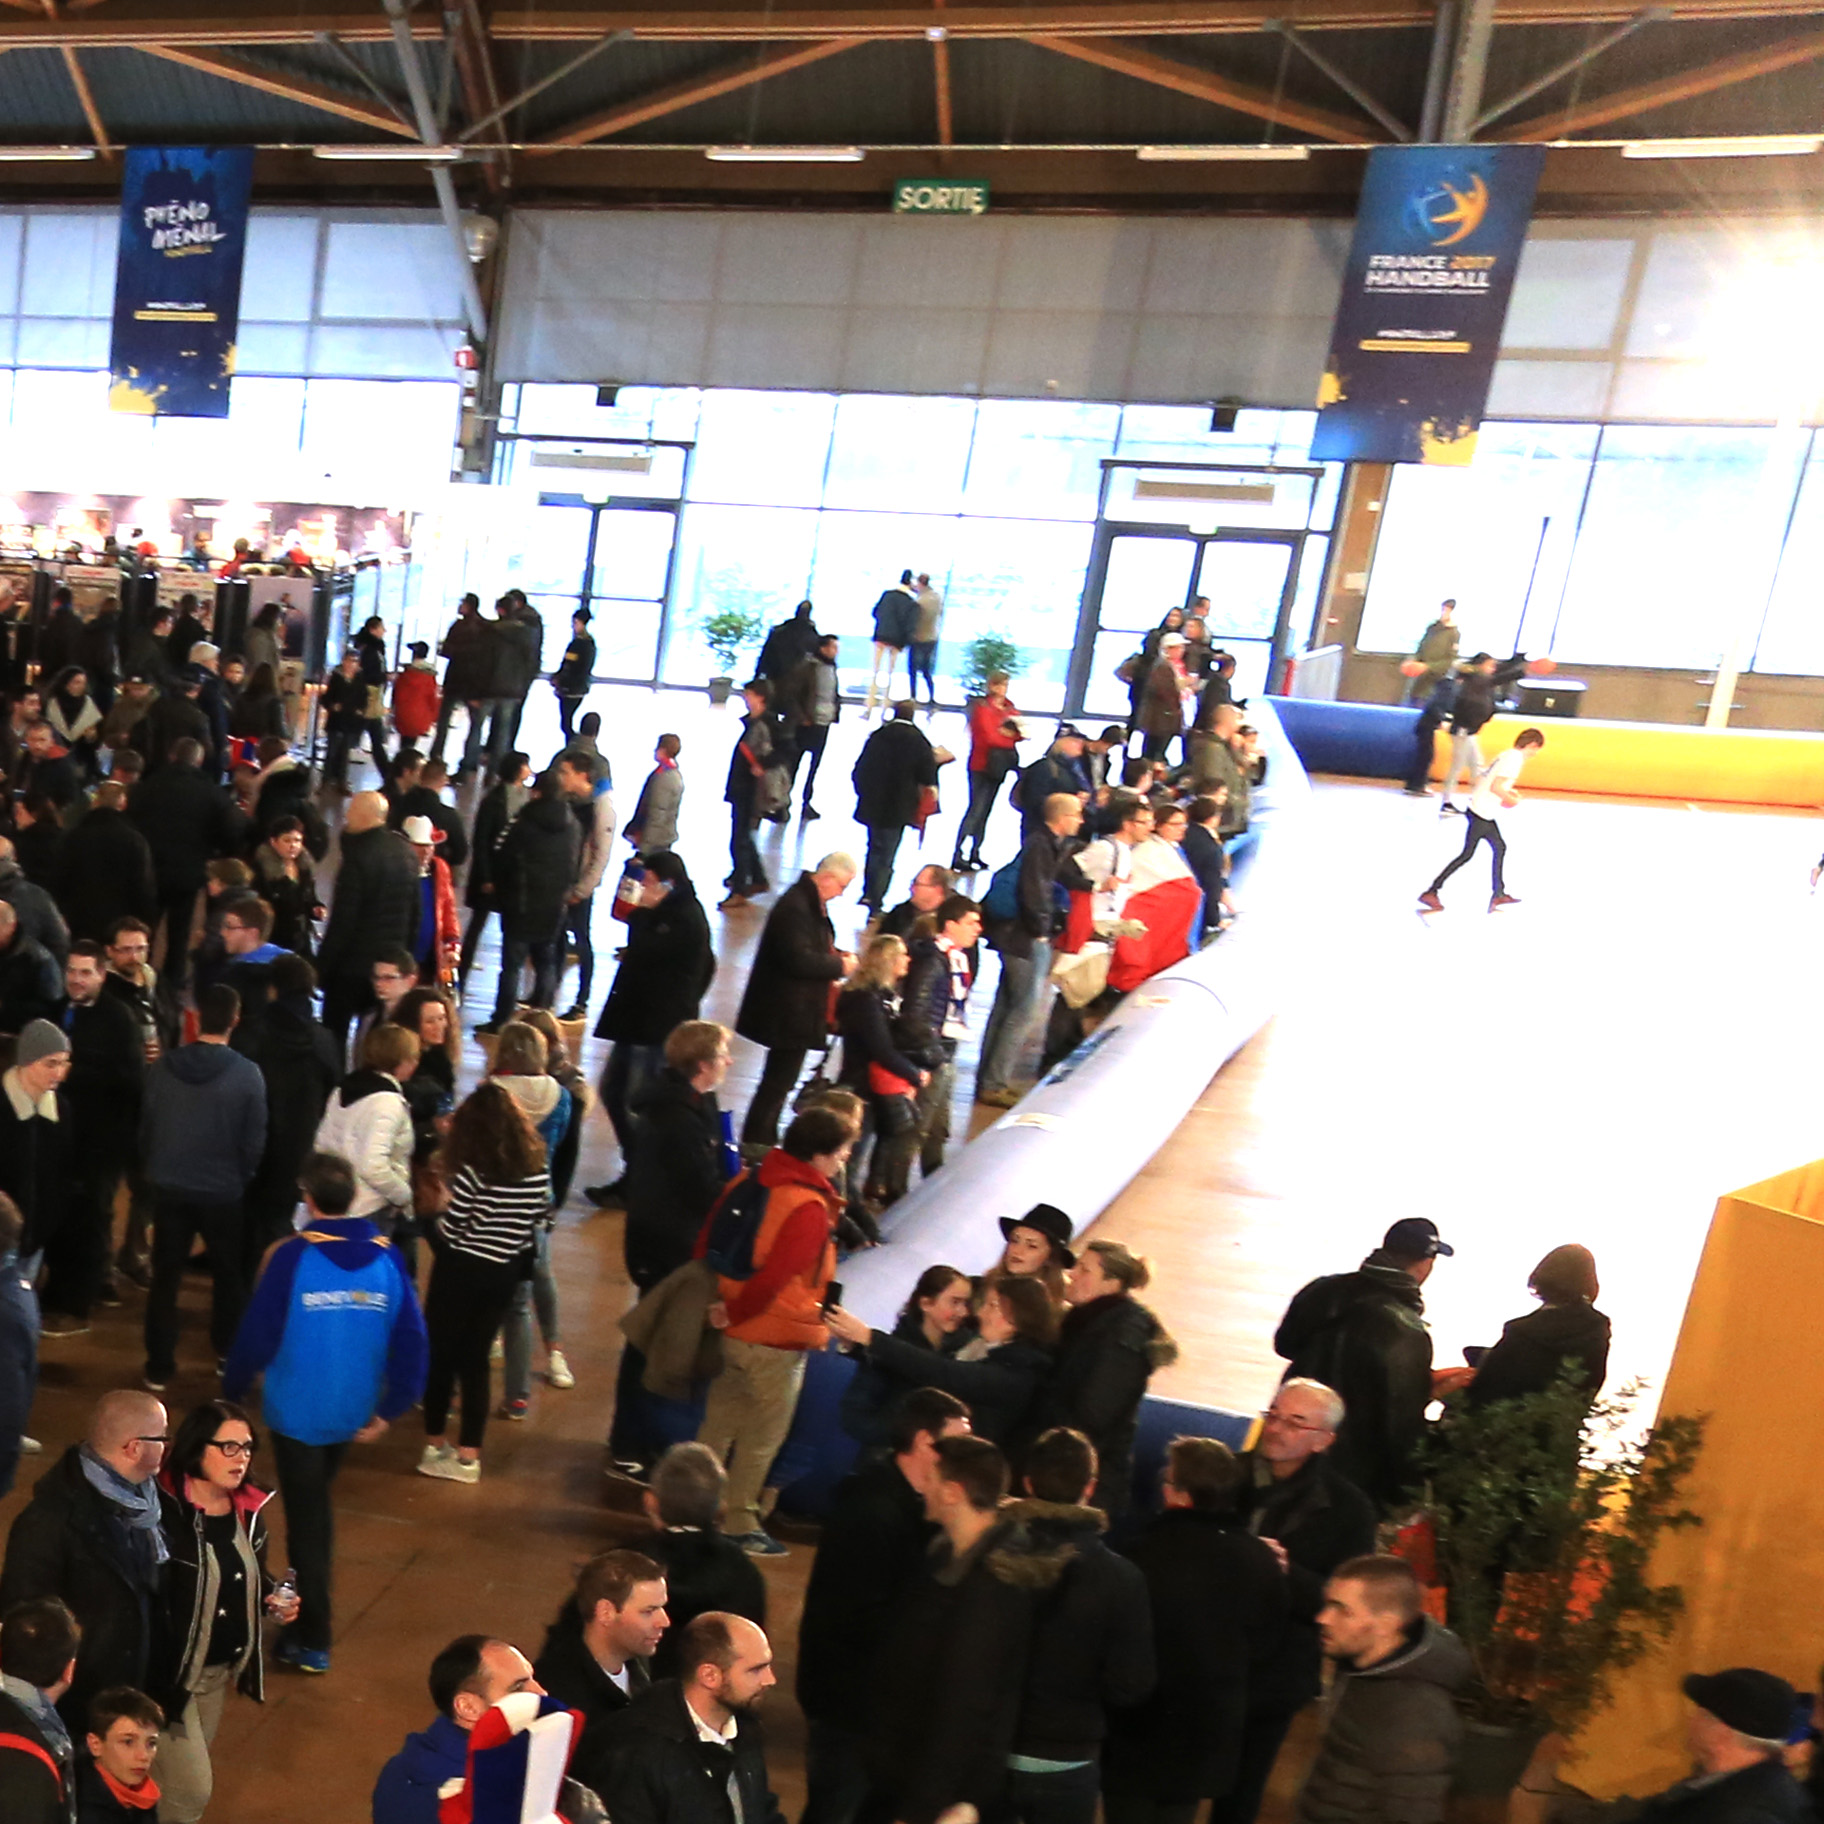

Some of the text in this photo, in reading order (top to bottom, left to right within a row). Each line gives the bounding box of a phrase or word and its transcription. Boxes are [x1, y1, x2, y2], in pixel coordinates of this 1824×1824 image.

[898, 187, 984, 211] SORTIE
[1368, 255, 1448, 269] FRANCE
[1364, 270, 1490, 288] HANDBALL
